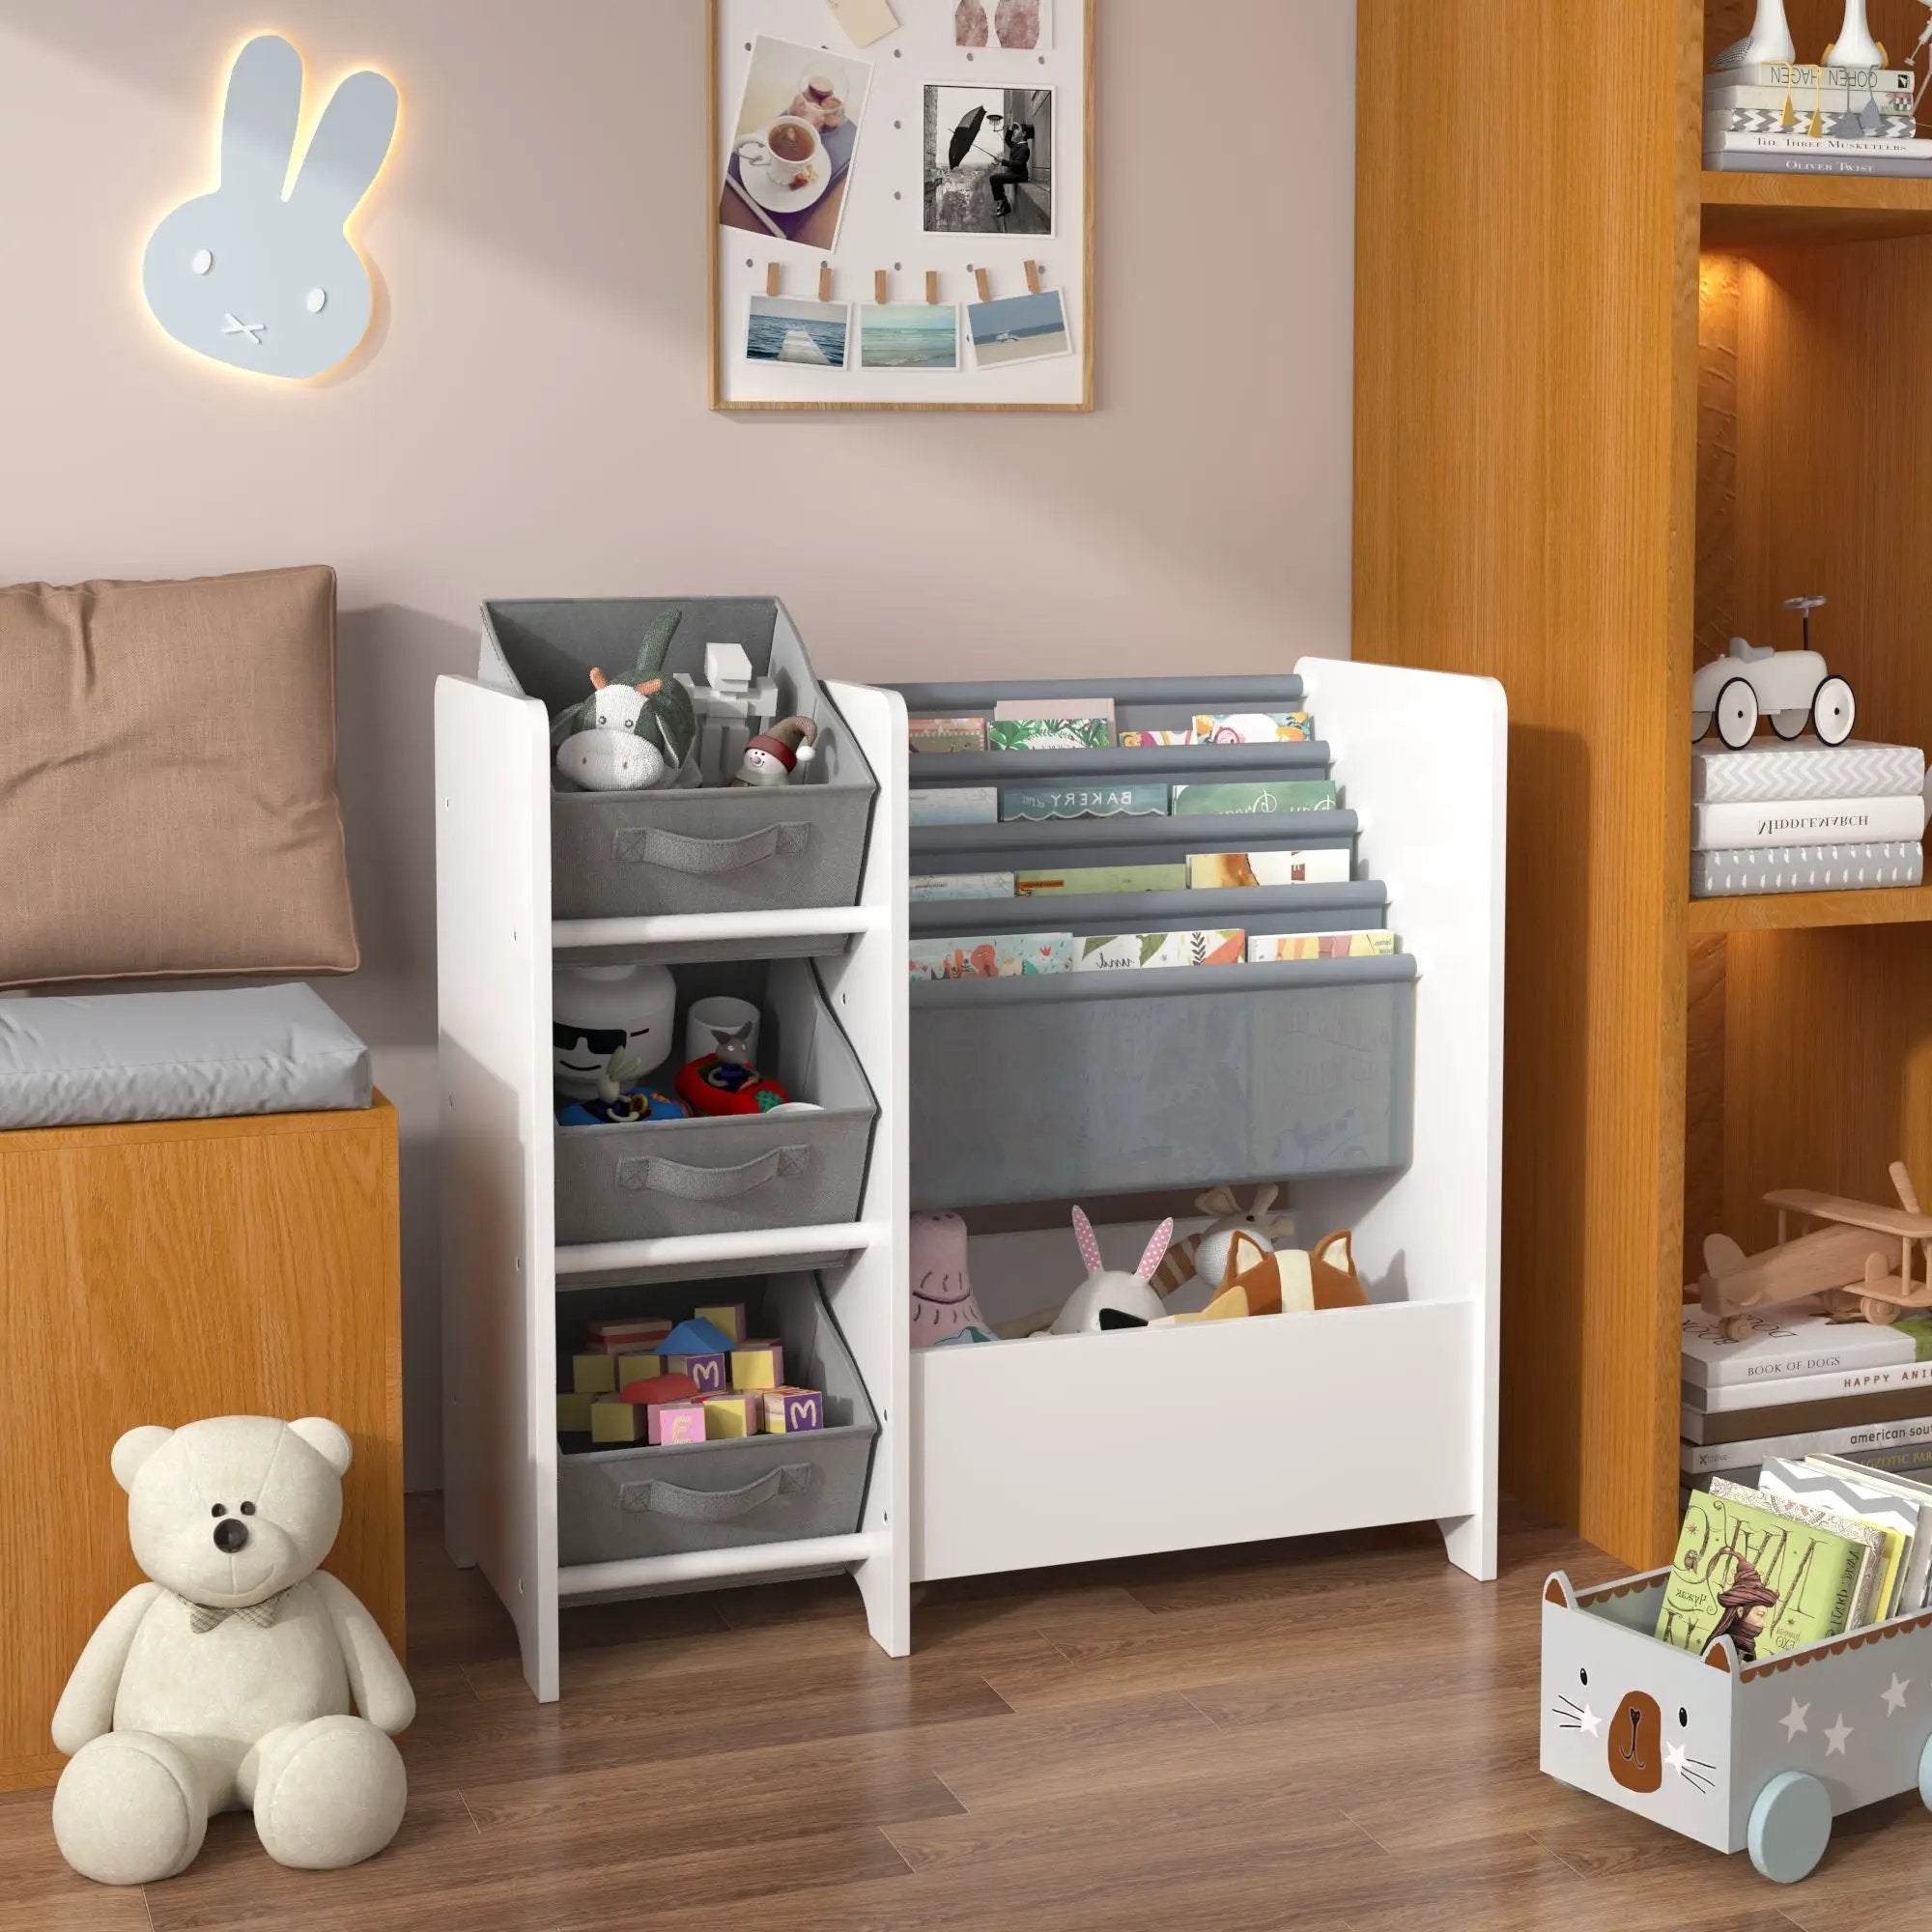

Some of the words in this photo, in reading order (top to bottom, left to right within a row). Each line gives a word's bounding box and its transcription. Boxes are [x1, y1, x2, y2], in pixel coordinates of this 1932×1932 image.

[1747, 1363, 1782, 1377] BOOK
[1786, 1360, 1804, 1372] OF
[1807, 1356, 1841, 1370] DOGS
[1843, 1373, 1890, 1388] HAPPY
[1850, 1427, 1906, 1445] american
